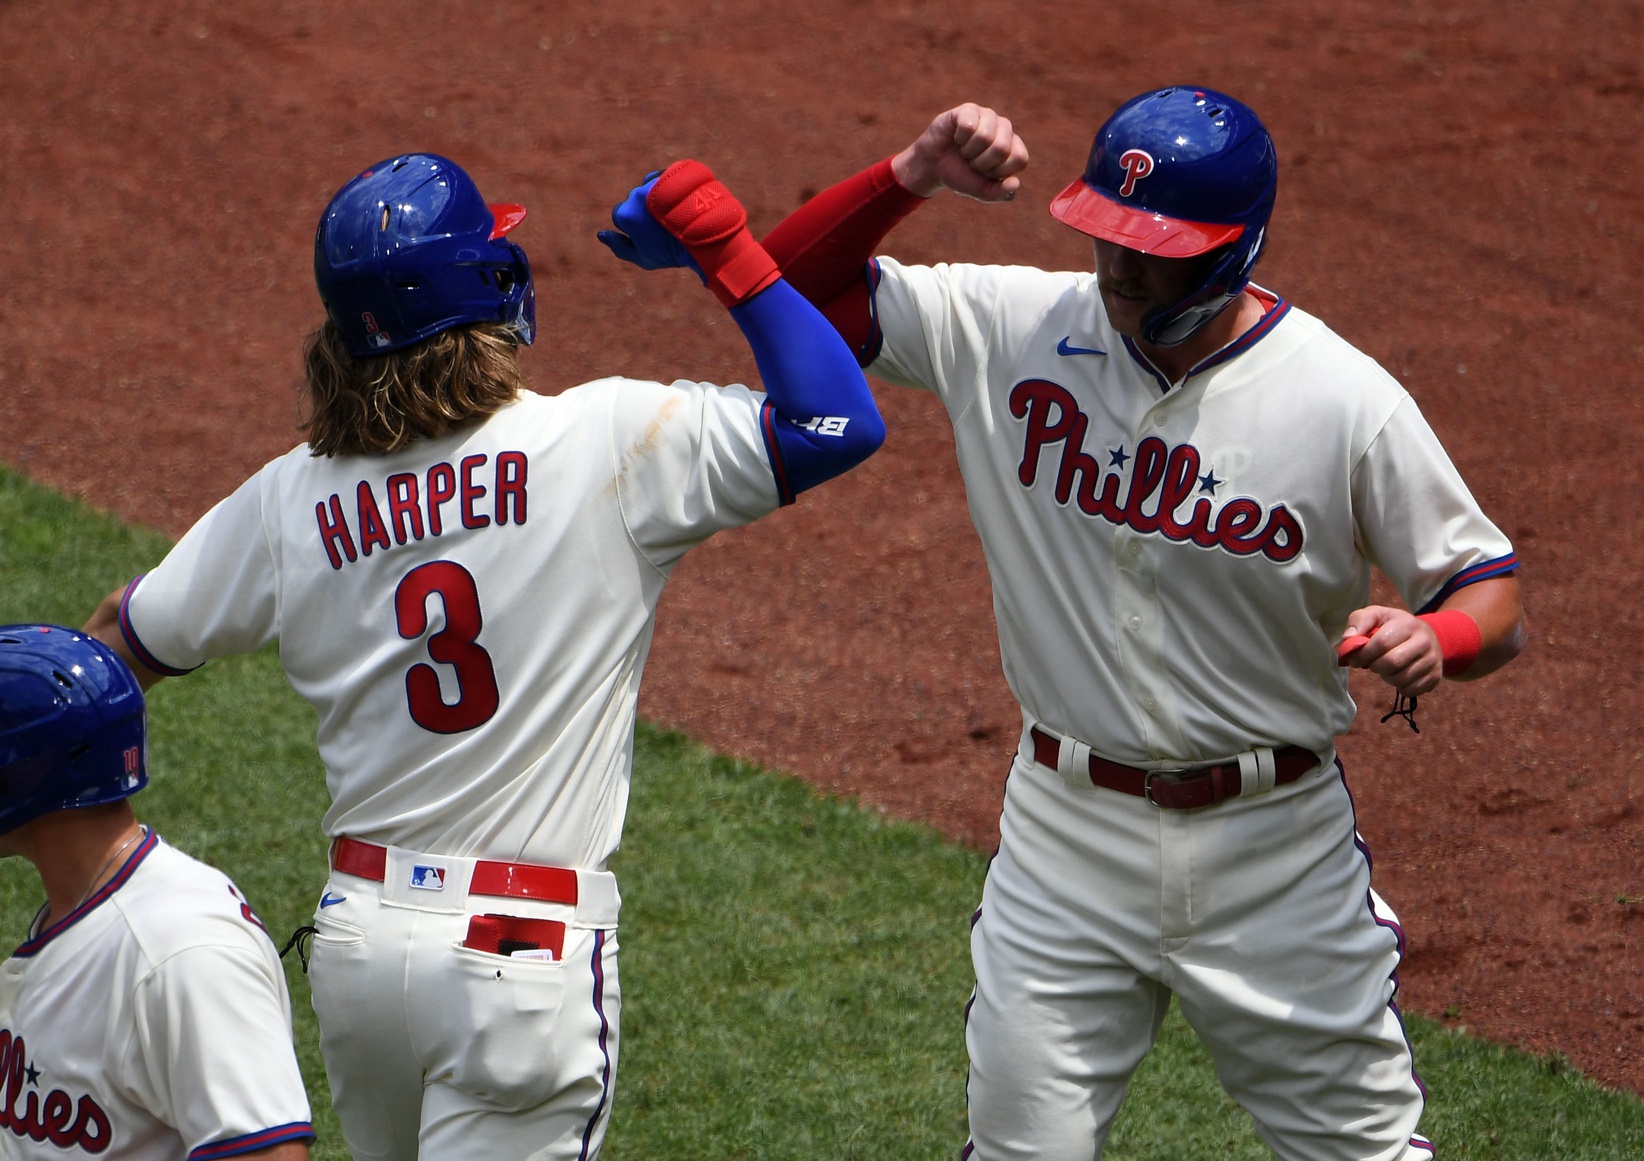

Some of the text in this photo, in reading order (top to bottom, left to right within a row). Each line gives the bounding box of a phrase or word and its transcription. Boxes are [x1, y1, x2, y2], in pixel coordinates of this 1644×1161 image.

[1119, 149, 1154, 197] P
[361, 311, 379, 334] 3
[315, 451, 528, 570] HARPER
[1008, 378, 1305, 564] Phillies
[394, 559, 500, 735] 3
[123, 746, 139, 774] 10
